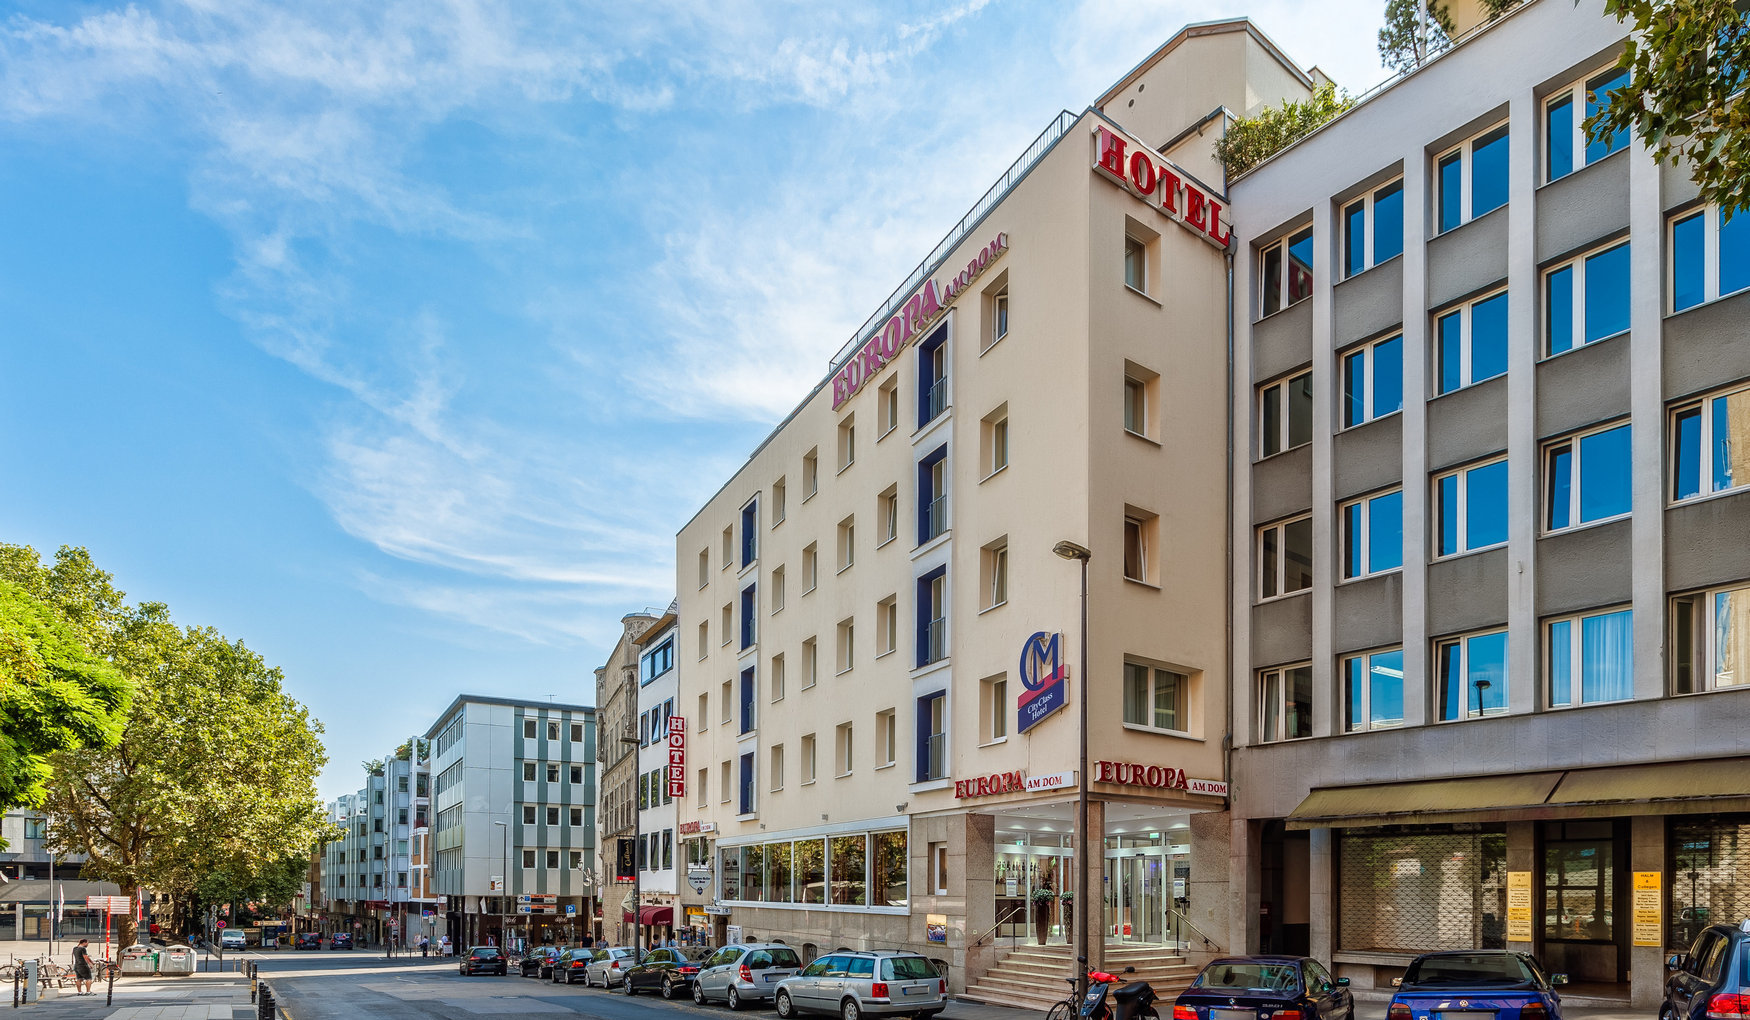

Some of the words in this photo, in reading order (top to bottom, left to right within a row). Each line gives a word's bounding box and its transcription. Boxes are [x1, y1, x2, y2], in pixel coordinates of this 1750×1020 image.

[1096, 124, 1230, 248] HOTEL
[832, 279, 941, 412] EUROPA
[943, 269, 968, 306] AM
[967, 231, 1006, 284] DOM
[1027, 692, 1053, 714] CityClass
[1031, 704, 1048, 721] Hotel
[670, 717, 684, 796] HOTEL
[954, 769, 1024, 799] EUROPA
[1027, 778, 1041, 790] AM
[1042, 775, 1062, 787] DOM
[1098, 760, 1189, 790] EUROPA
[1192, 781, 1206, 792] AM
[1207, 783, 1227, 794] DOM
